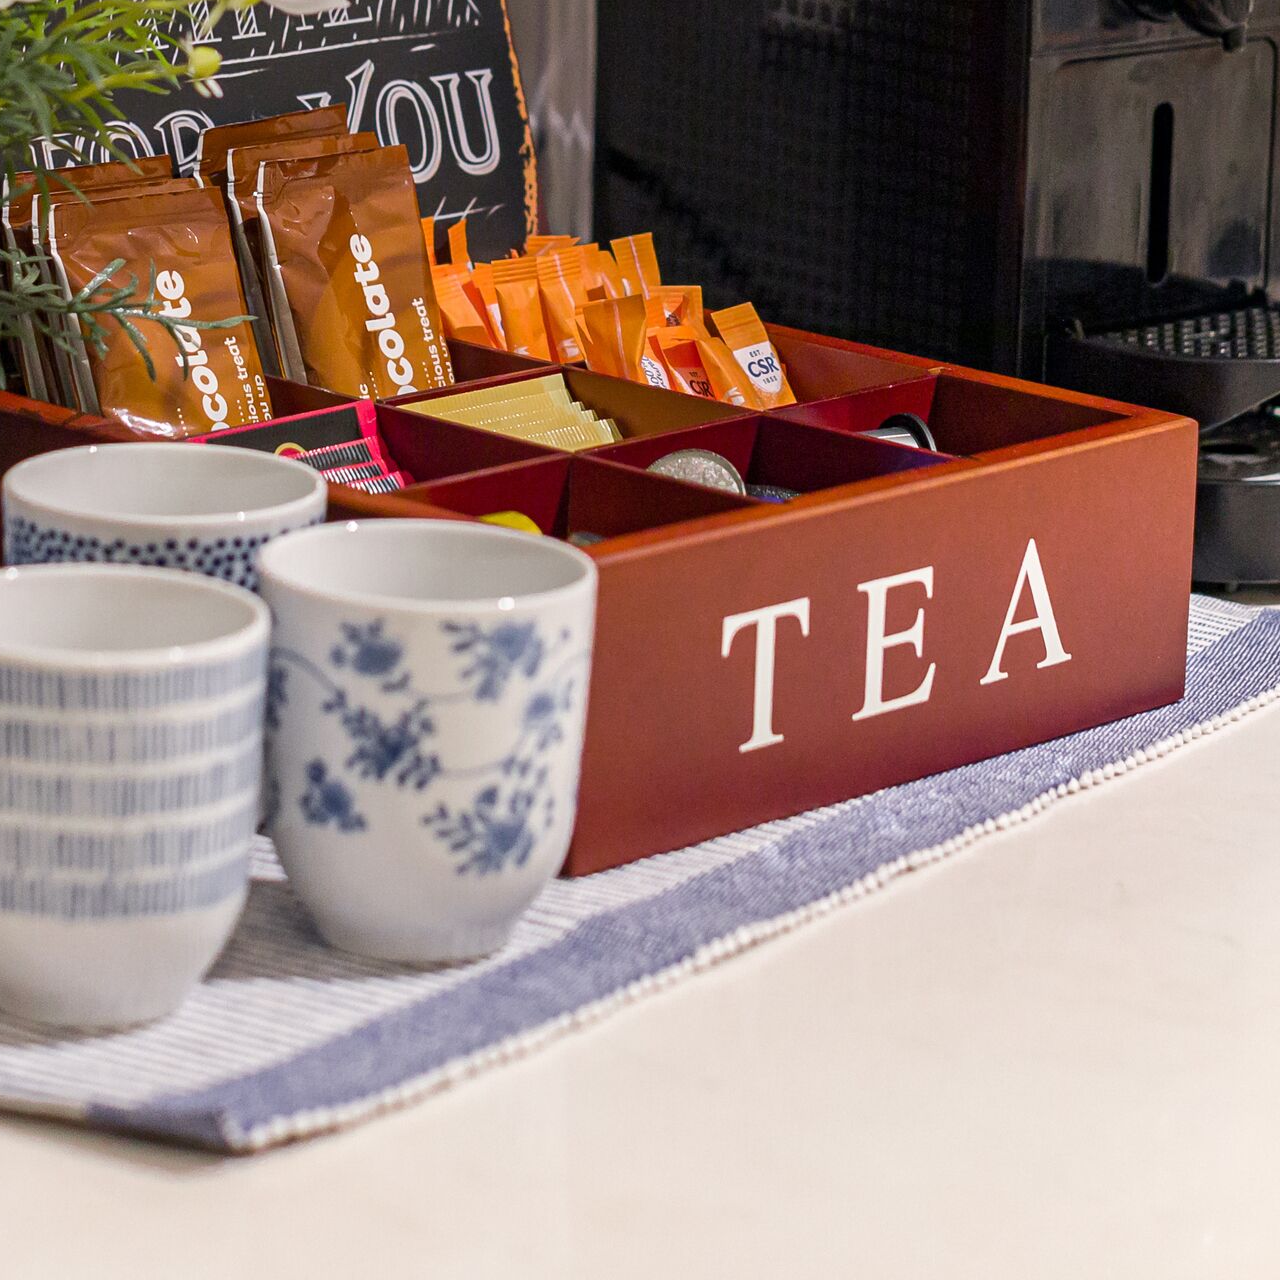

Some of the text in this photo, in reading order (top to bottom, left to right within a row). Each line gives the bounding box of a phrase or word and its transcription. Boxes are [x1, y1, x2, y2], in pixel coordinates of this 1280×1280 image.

[412, 297, 435, 342] treat
[224, 336, 260, 423] ious treat
[747, 356, 780, 378] CSR
[721, 537, 1072, 753] TEA
